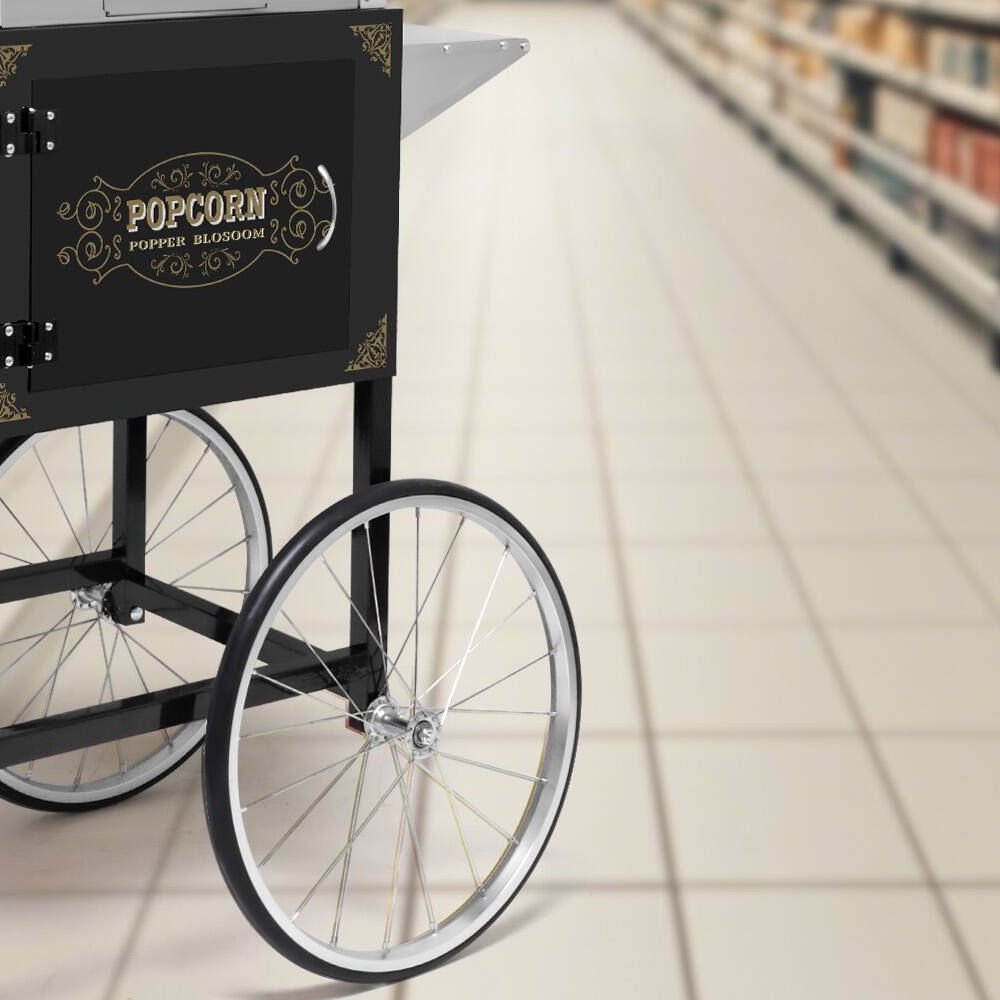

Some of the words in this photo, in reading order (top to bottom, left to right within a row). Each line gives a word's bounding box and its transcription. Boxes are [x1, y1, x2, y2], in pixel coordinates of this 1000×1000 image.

[126, 187, 267, 233] POPCORN
[129, 236, 186, 251] POPPER
[193, 227, 265, 246] BLOSOOM
